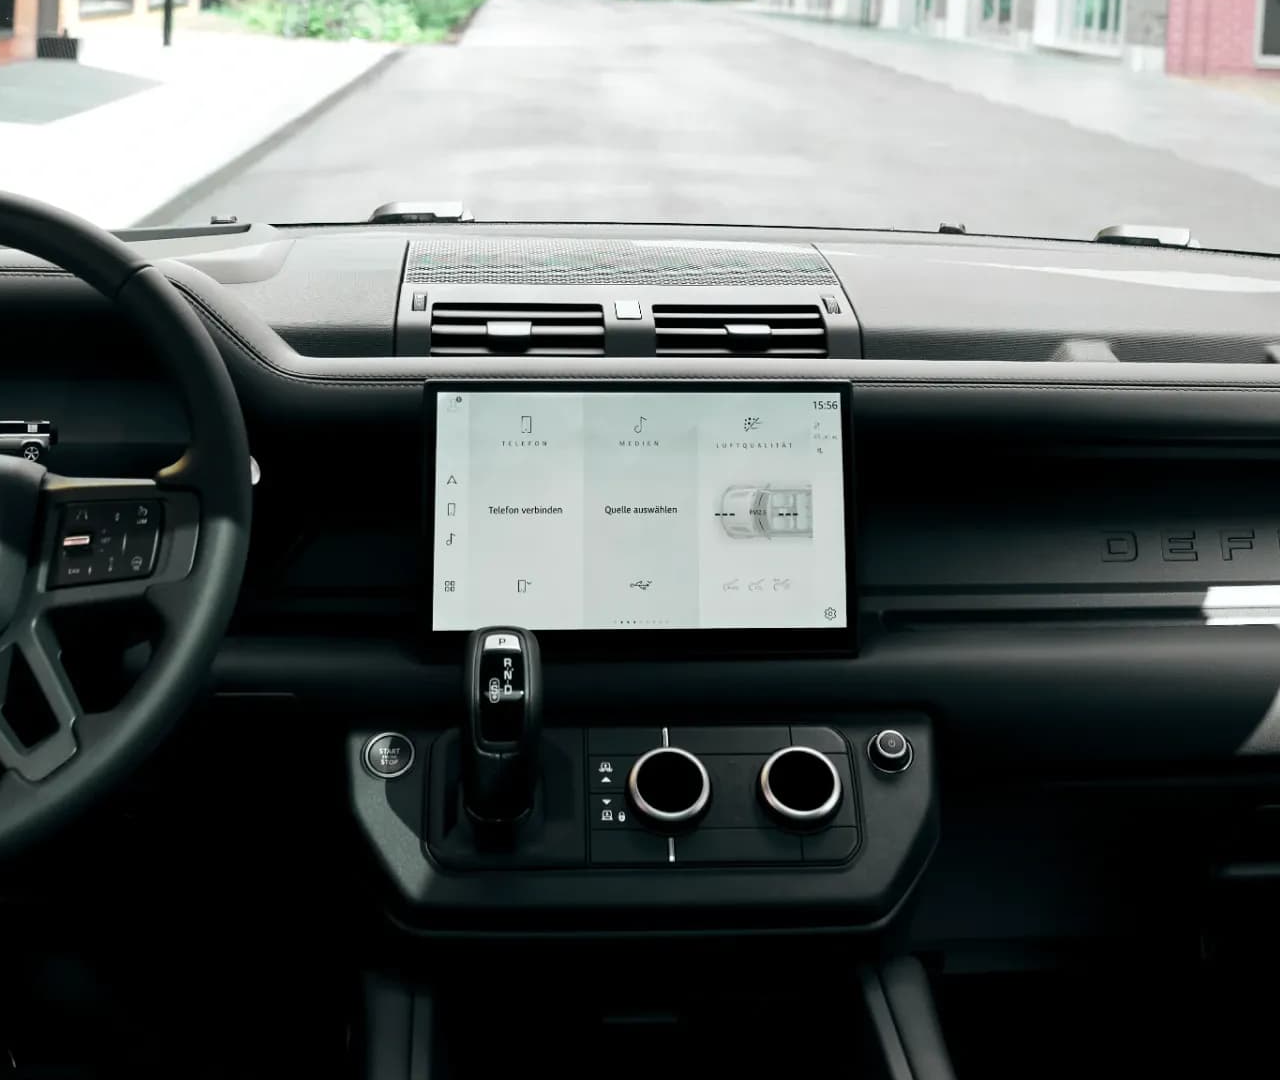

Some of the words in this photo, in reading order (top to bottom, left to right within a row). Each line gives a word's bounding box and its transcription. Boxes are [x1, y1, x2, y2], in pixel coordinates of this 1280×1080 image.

[812, 400, 838, 410] 15:56
[488, 505, 519, 515] Telefon
[521, 505, 563, 515] verbinden
[604, 505, 631, 516] Quelle
[633, 505, 678, 515] auswählen
[503, 658, 512, 667] R
[503, 671, 512, 680] N
[504, 685, 513, 695] D
[379, 747, 401, 755] START
